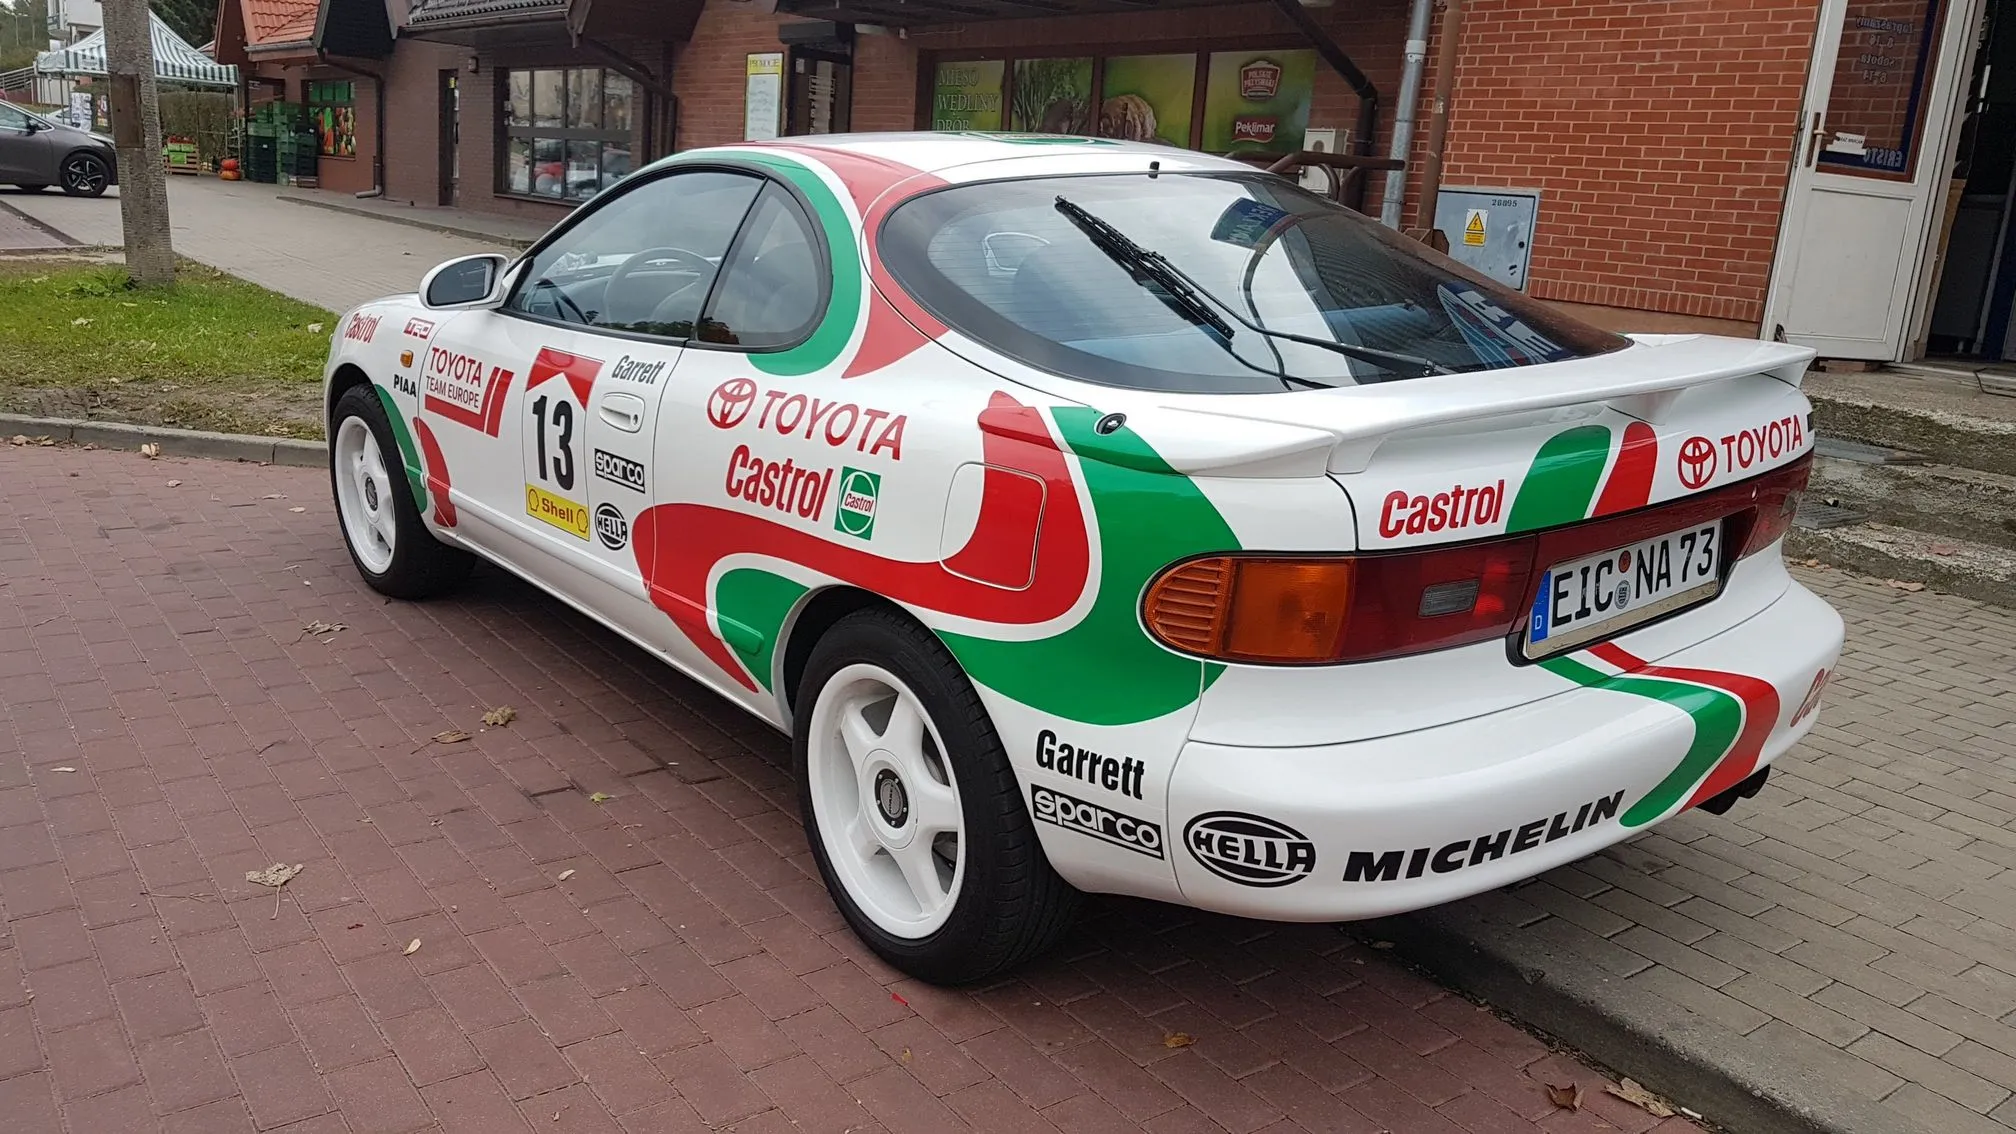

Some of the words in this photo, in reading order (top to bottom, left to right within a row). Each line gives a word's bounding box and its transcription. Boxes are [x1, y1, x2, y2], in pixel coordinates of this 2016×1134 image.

[937, 93, 998, 115] WĘDLINY
[1235, 121, 1276, 136] Peklimar
[344, 312, 383, 344] Castrol
[393, 374, 417, 398] PIAA
[430, 346, 483, 388] TOYOTA
[611, 354, 666, 385] Garrett
[426, 376, 446, 397] TEAM
[447, 385, 480, 409] EUROPE
[532, 394, 575, 491] 13
[757, 389, 908, 461] TOYOTA
[1720, 413, 1803, 473] TOYOTA
[595, 452, 645, 486] sparco
[725, 444, 834, 522] Castrol
[541, 498, 574, 524] Shell
[843, 493, 874, 513] Castrol
[1378, 479, 1505, 539] Castrol
[597, 515, 628, 543] HELLA
[1551, 558, 1615, 629] EIC
[1635, 539, 1672, 600] NA
[1680, 525, 1715, 584] 73
[1534, 613, 1544, 632] D
[1035, 729, 1146, 801] Garrett
[1034, 789, 1160, 849] sparco
[1341, 789, 1626, 883] MICHELIN
[1192, 826, 1317, 875] HELLA
